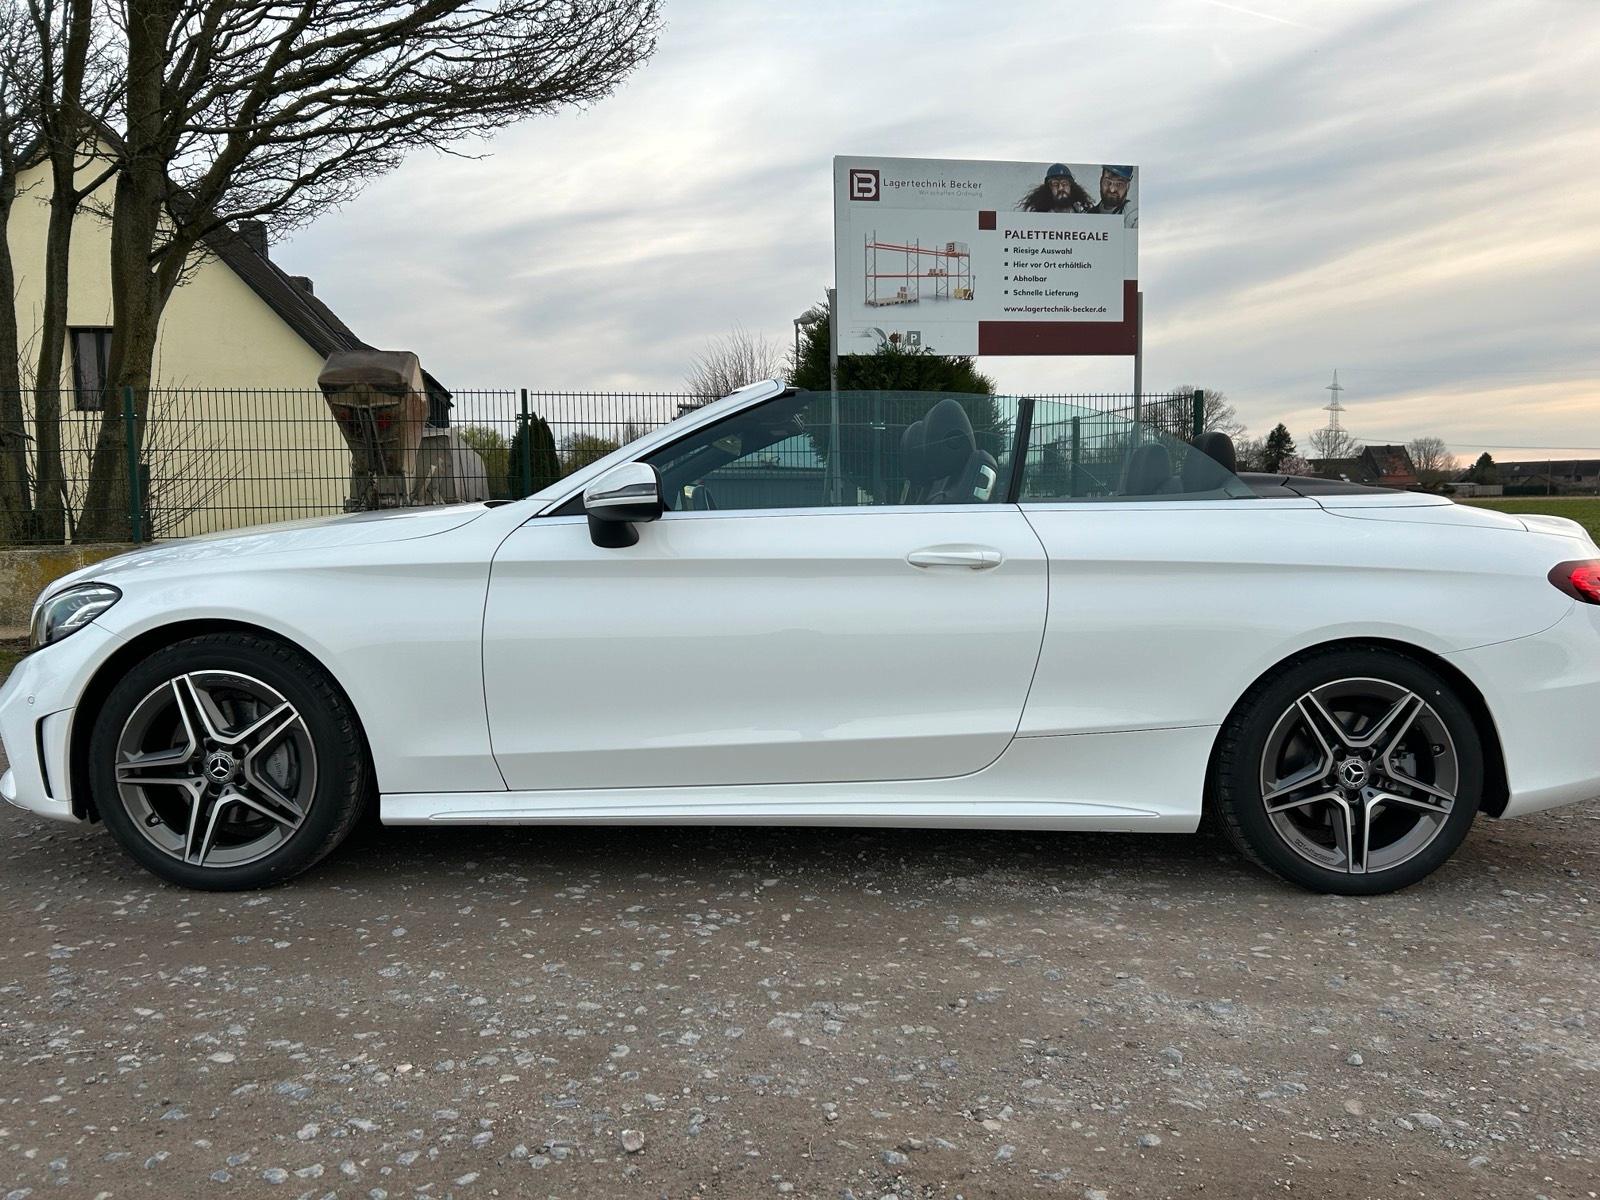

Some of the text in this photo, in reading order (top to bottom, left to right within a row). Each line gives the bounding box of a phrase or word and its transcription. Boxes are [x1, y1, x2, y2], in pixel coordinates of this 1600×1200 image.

[883, 178, 982, 189] Lagertechnik Becker
[1004, 230, 1109, 241] PALETTENREGALE
[1013, 247, 1073, 256] Riesige Auswahl
[1013, 261, 1028, 269] Hier
[1043, 261, 1056, 269] Ort
[1058, 261, 1092, 269] erhältlich
[1013, 275, 1047, 283] Abholbar
[1013, 289, 1079, 298] Schnelle Lieferung
[1003, 305, 1107, 314] www.lagertechnik-becker.de
